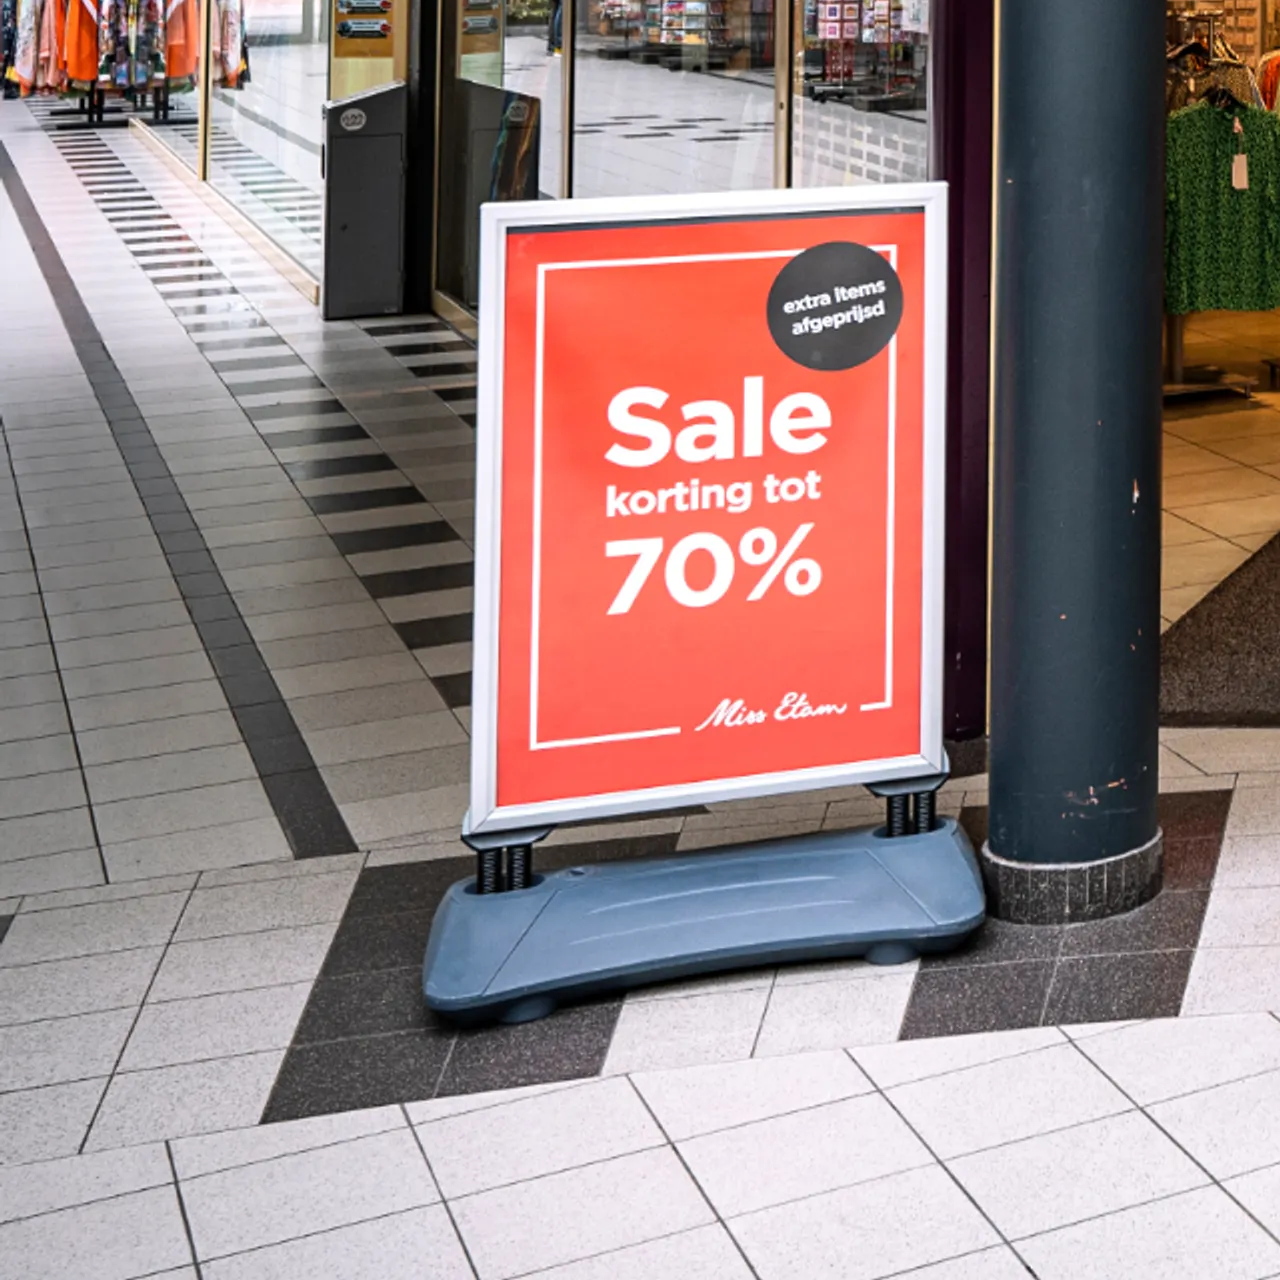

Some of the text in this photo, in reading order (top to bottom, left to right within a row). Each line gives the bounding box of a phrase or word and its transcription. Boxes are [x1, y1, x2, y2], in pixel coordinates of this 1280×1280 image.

[783, 278, 886, 315] extra items
[791, 300, 886, 336] afgeprijsd
[604, 375, 832, 468] Sale
[606, 469, 822, 518] korting tot
[604, 522, 822, 616] 70%
[695, 692, 848, 731] Miss Etam
